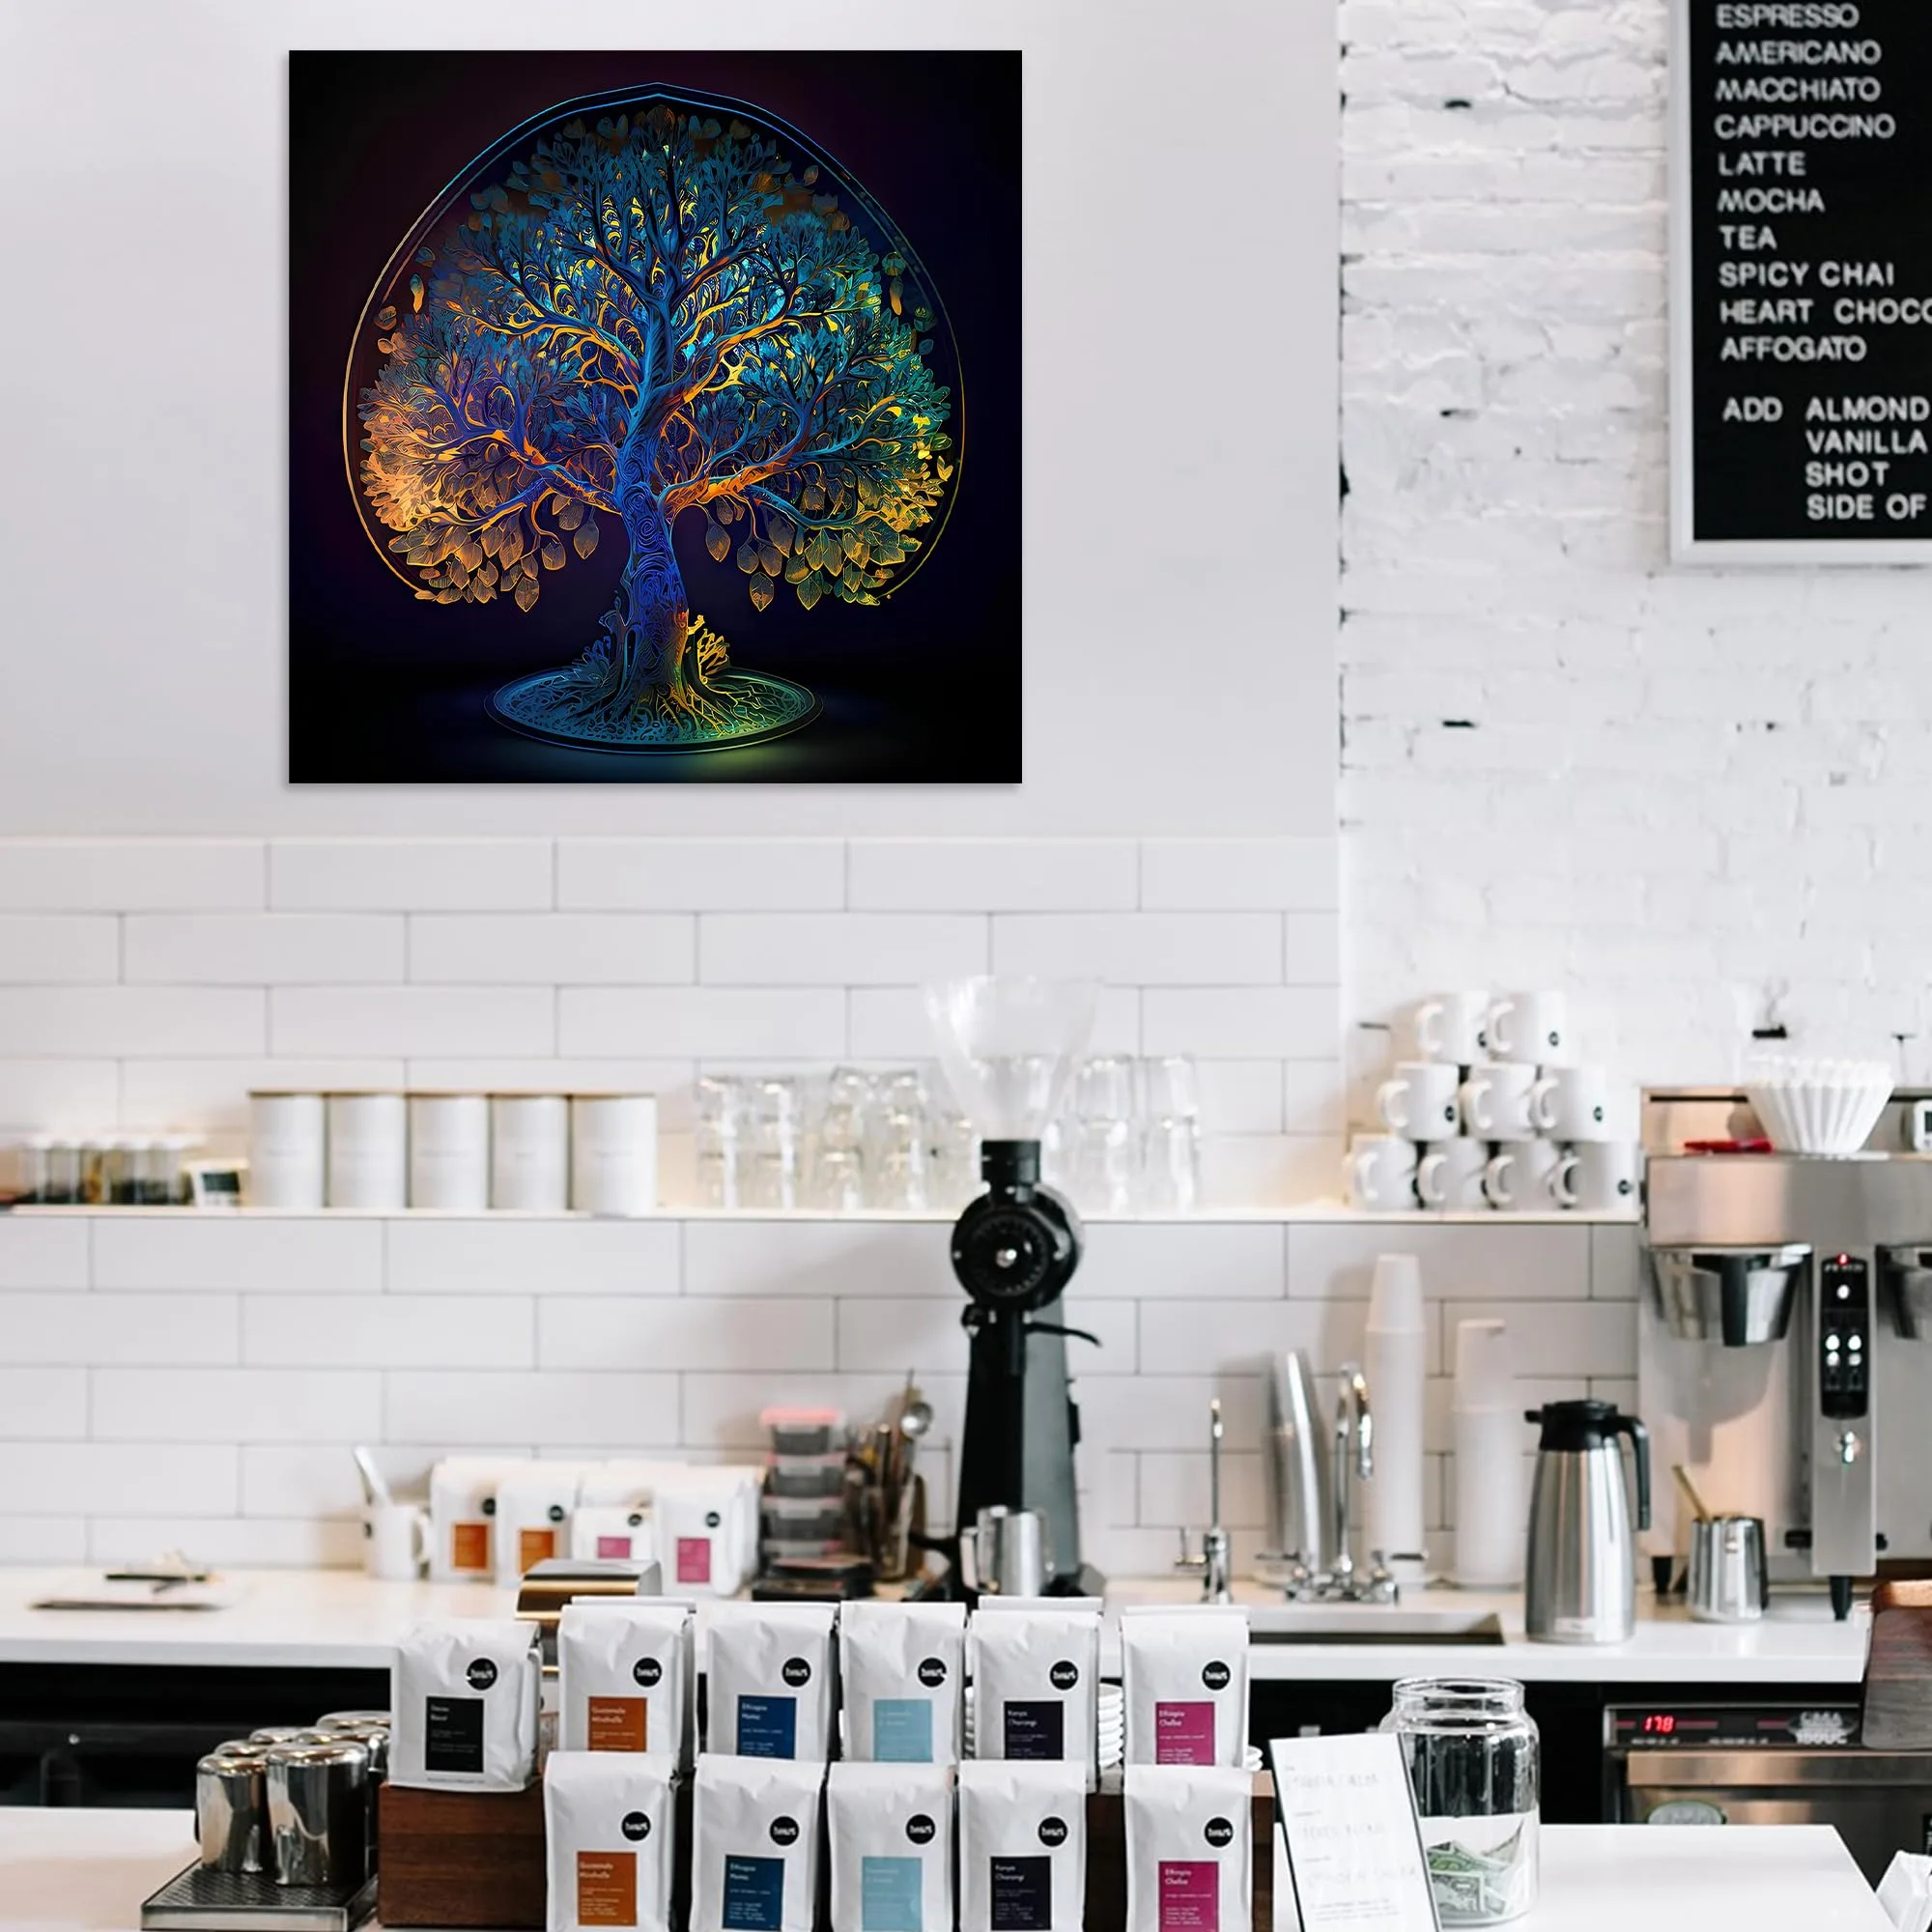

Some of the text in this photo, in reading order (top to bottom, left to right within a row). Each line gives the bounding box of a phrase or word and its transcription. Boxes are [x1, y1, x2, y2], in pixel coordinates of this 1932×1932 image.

[1717, 3, 1860, 28] ESPRESSO
[1716, 40, 1882, 65] AMERICANO
[1716, 76, 1881, 101] MACCHIATO
[1715, 114, 1895, 139] CAPPUCCINO
[1719, 151, 1805, 176] LATTE
[1718, 188, 1825, 213] MOCHA
[1719, 225, 1776, 250] TEA
[1719, 262, 1893, 287] SPICY CHAI
[1720, 298, 1813, 324] HEART
[1721, 335, 1866, 361] AFFOGATO
[1723, 396, 1930, 421] ADD ALMOND
[1805, 430, 1927, 454] VANILLA
[1805, 462, 1889, 487] SHOT
[1807, 494, 1926, 520] SIDE OF
